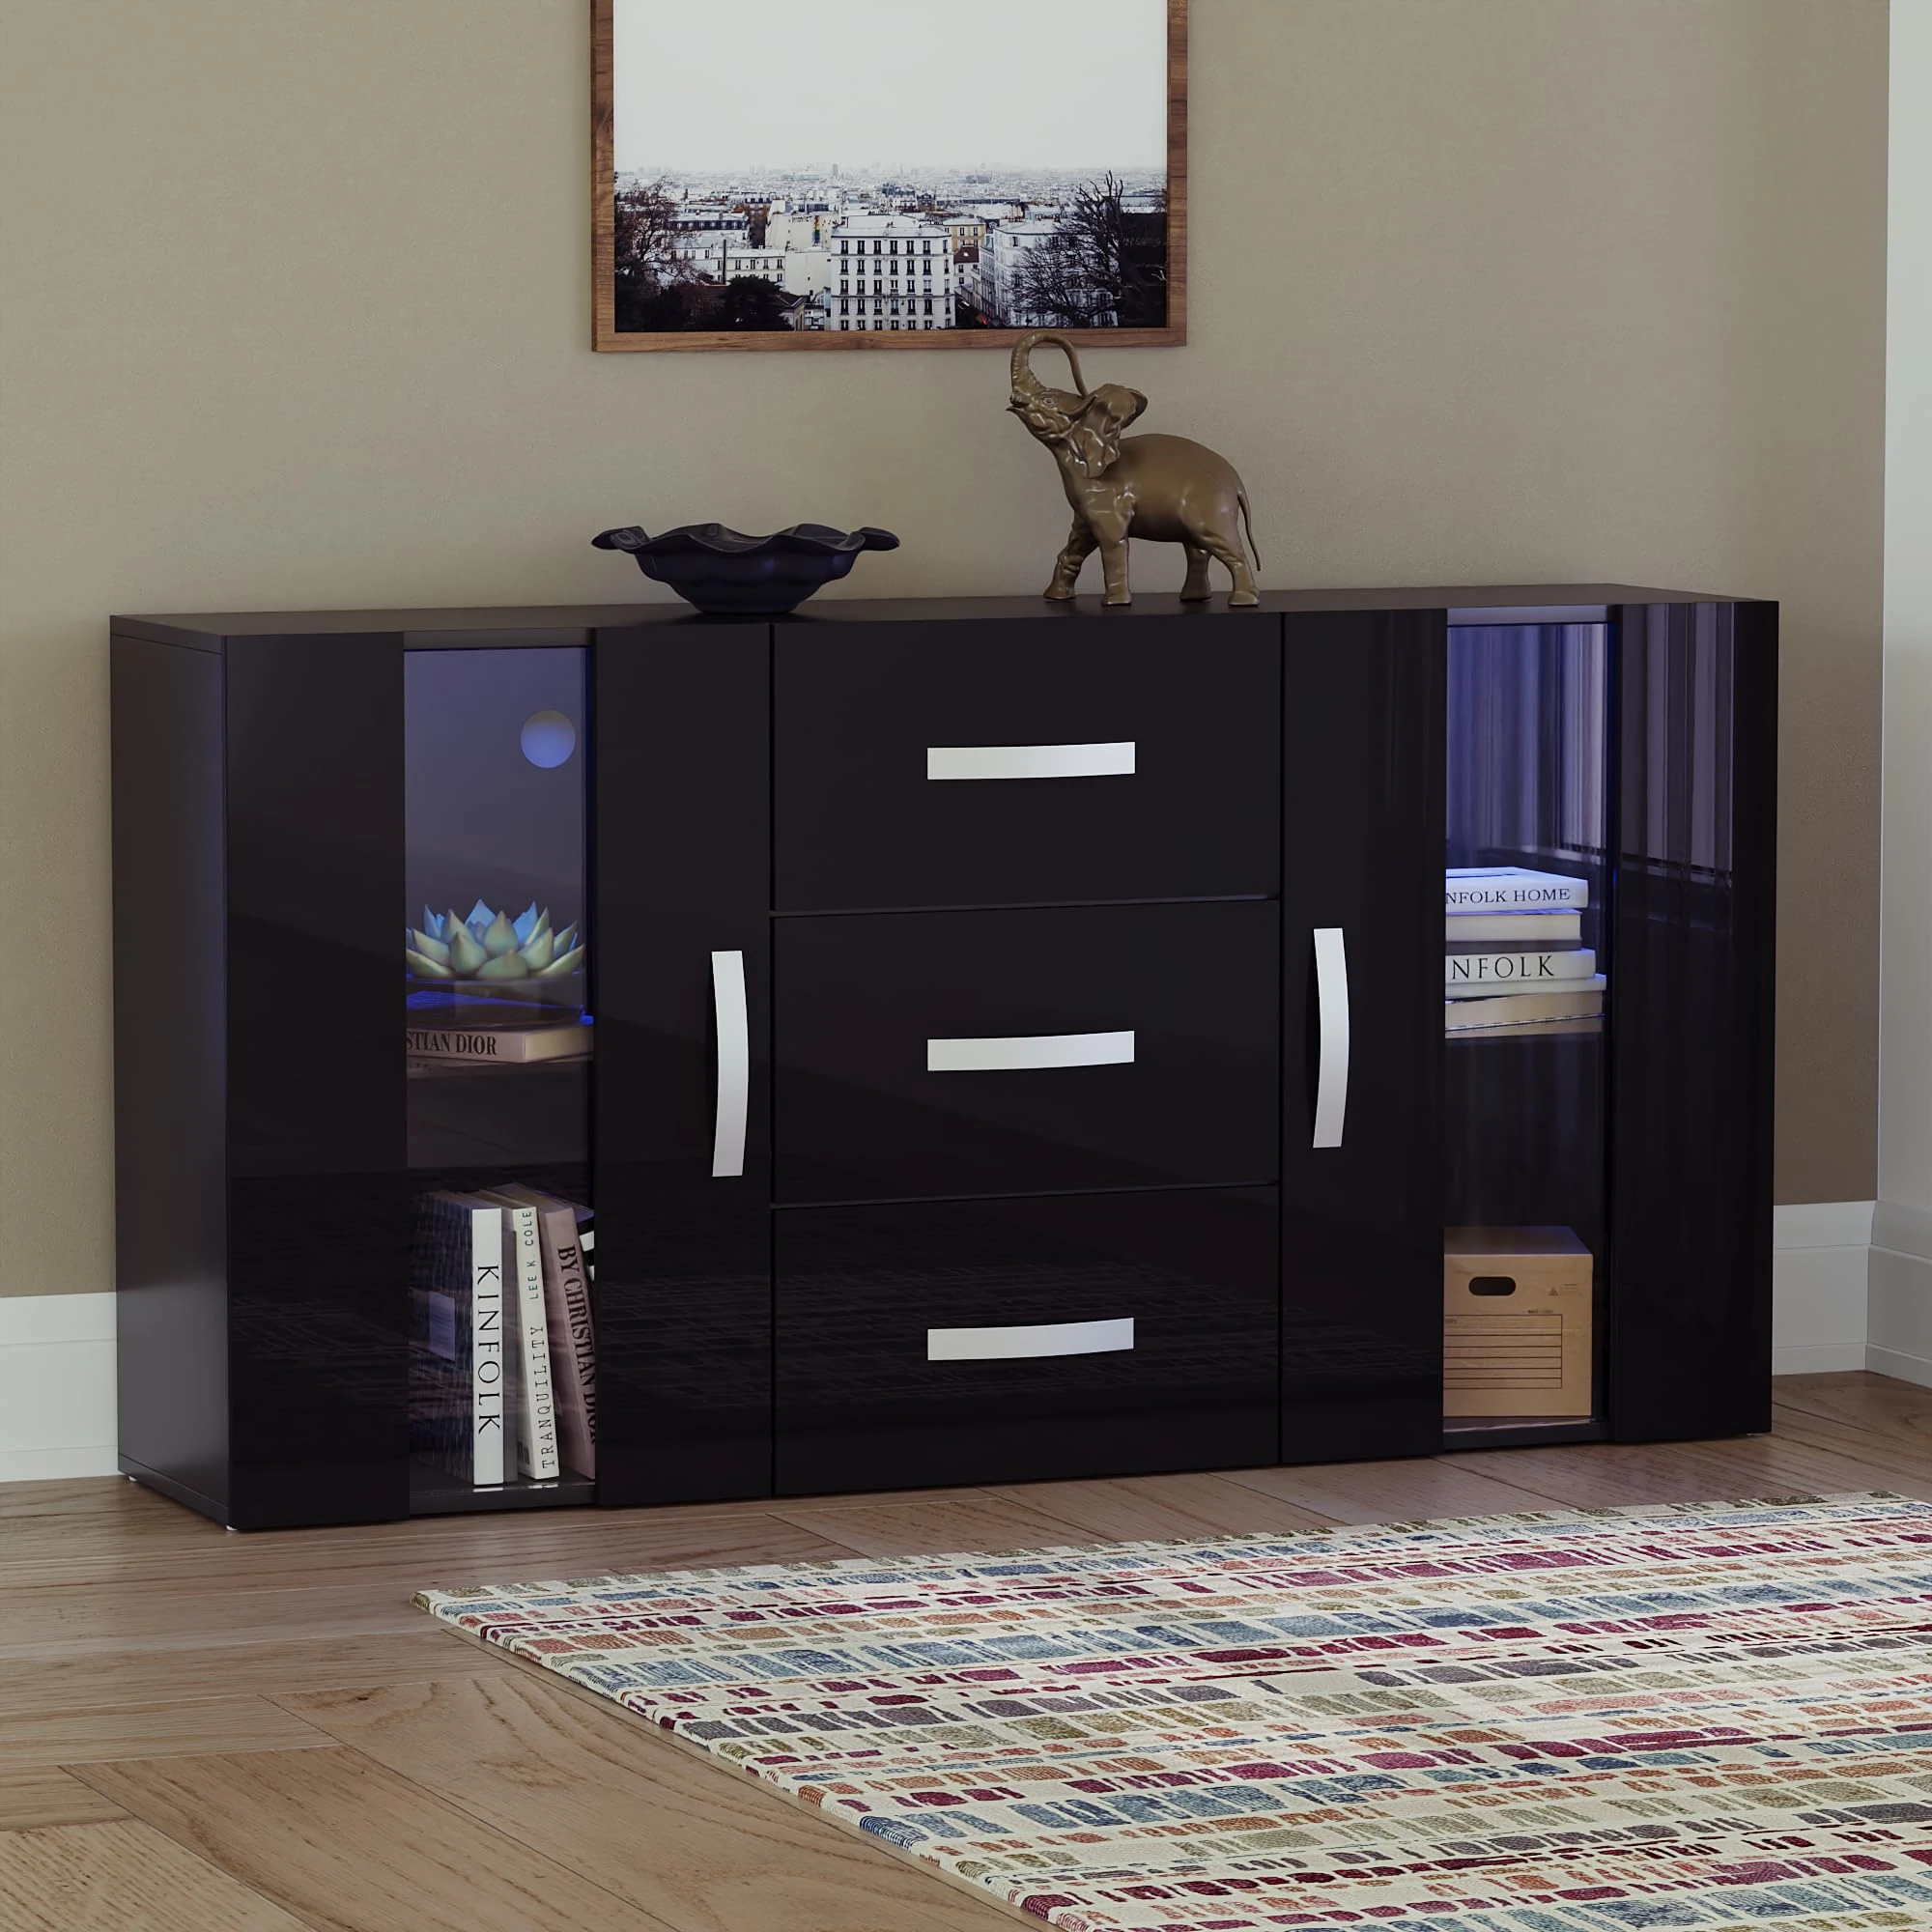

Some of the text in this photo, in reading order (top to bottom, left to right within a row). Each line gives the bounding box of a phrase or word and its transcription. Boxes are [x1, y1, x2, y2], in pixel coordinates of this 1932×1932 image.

[1514, 888, 1571, 902] HOME
[1452, 954, 1555, 980] NFOLK
[456, 1033, 497, 1055] DIOR
[522, 1211, 534, 1246] COLE
[557, 1243, 580, 1272] BY
[527, 1275, 539, 1300] LEE
[564, 1277, 596, 1386] CHRISTIAN
[477, 1264, 500, 1435] KINFOLK
[529, 1325, 555, 1469] TRANQUILITY
